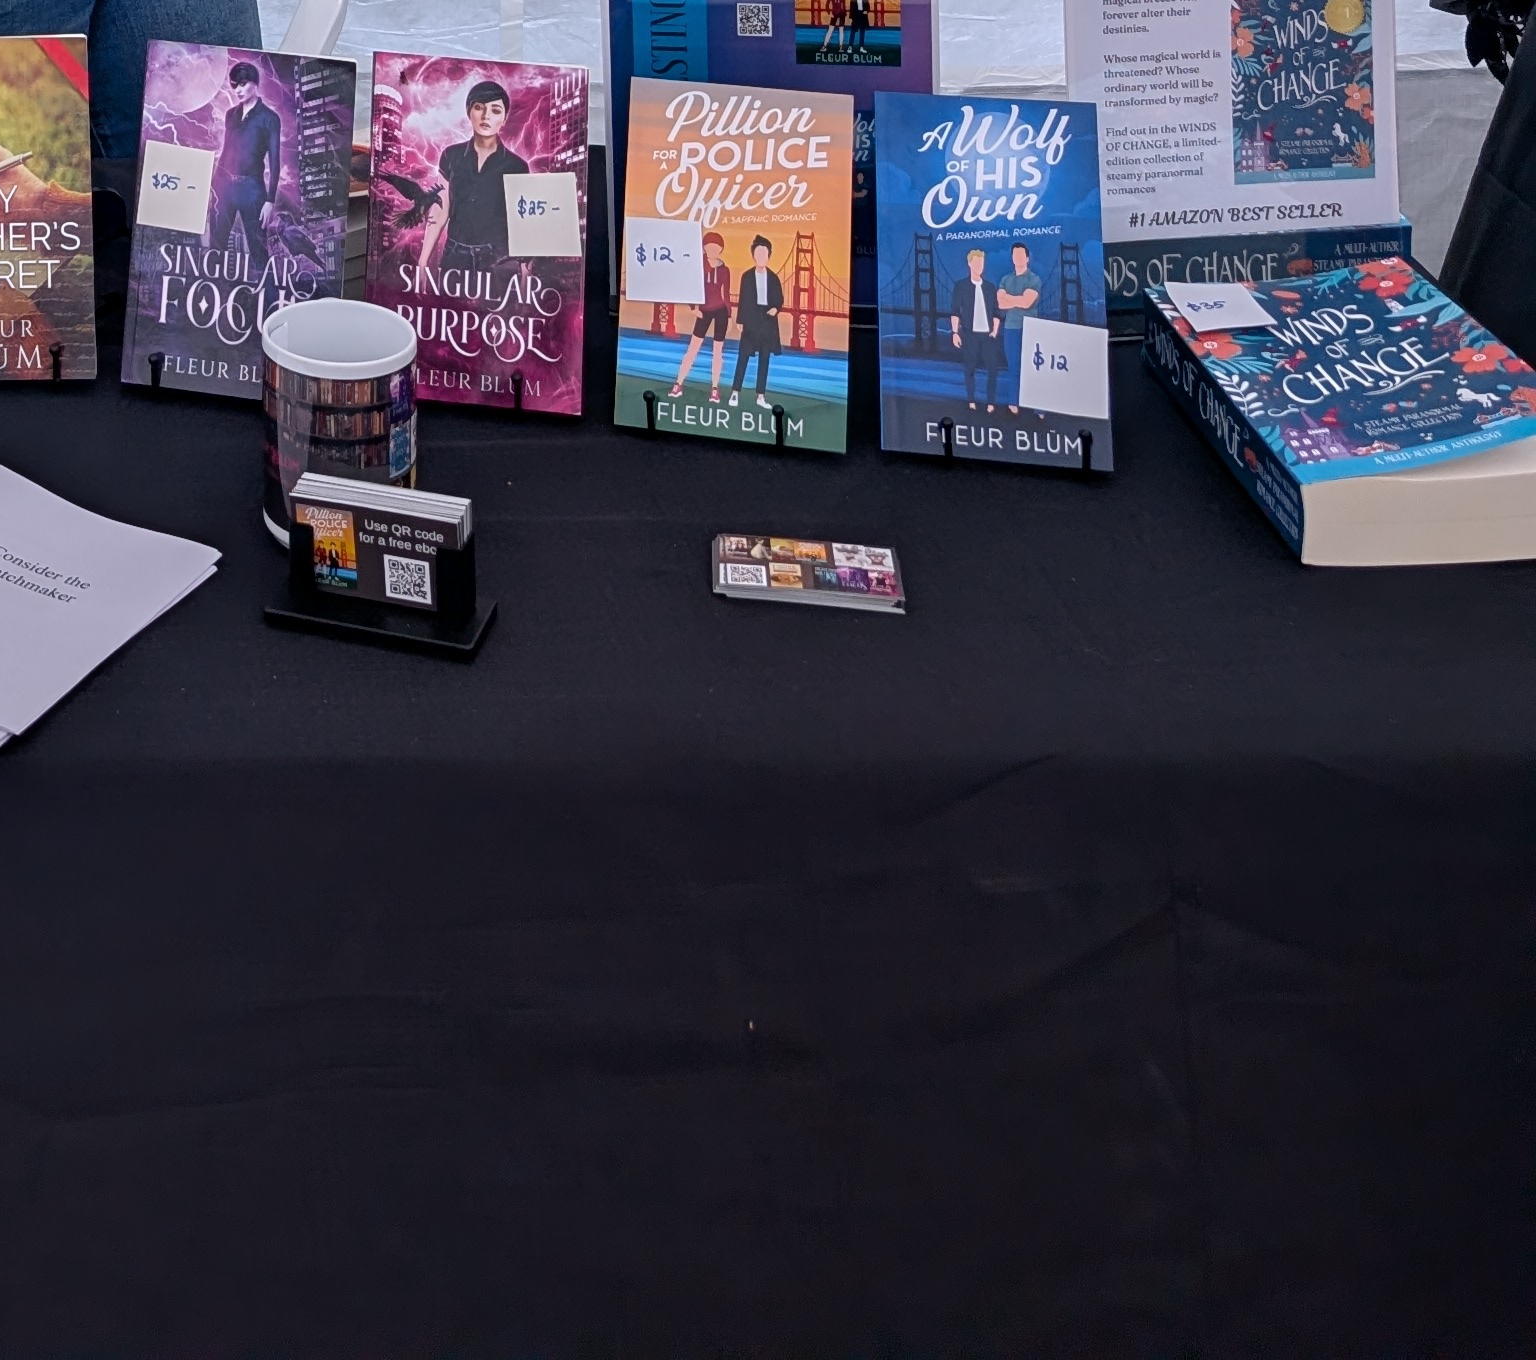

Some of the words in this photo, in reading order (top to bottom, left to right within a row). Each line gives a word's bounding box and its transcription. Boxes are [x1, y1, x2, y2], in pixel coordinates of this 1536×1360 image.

[1103, 10, 1138, 20] forever
[1141, 8, 1164, 18] alter
[1166, 8, 1191, 17] their
[1103, 24, 1149, 34] destinies.
[1273, 9, 1328, 49] WINDS
[1292, 47, 1308, 66] OF
[1257, 59, 1346, 111] CHANGE
[666, 91, 815, 142] Pillion
[918, 121, 953, 152] A
[952, 104, 1072, 165] Wolf
[653, 150, 677, 160] FOR
[660, 161, 667, 170] A
[679, 136, 831, 174] POLICE
[947, 160, 969, 172] OF
[975, 156, 1042, 190] HIS
[656, 164, 813, 228] Officer
[922, 175, 1043, 229] Own
[1129, 213, 1145, 227] #1
[1148, 208, 1224, 226] AMAZON
[1227, 206, 1274, 222] BEST
[1277, 202, 1343, 219] SELLER
[946, 229, 1010, 240] PARANORMAL
[1013, 226, 1061, 236] ROMANCE
[160, 243, 316, 299] SINGULAR
[1186, 250, 1279, 283] CHANGE
[400, 264, 562, 316] SINGULAR
[398, 305, 562, 362] PURPOSE
[1266, 305, 1374, 348] WINDS
[1325, 339, 1349, 359] OF
[164, 355, 229, 379] FLEUR
[1282, 336, 1450, 404] CHANGE
[657, 402, 728, 429] FLEUR
[359, 532, 374, 543] for
[378, 537, 386, 546] a
[389, 536, 411, 550] free
[364, 519, 388, 532] Use
[391, 524, 412, 537] QR
[415, 529, 443, 542] code
[64, 576, 91, 591] the
